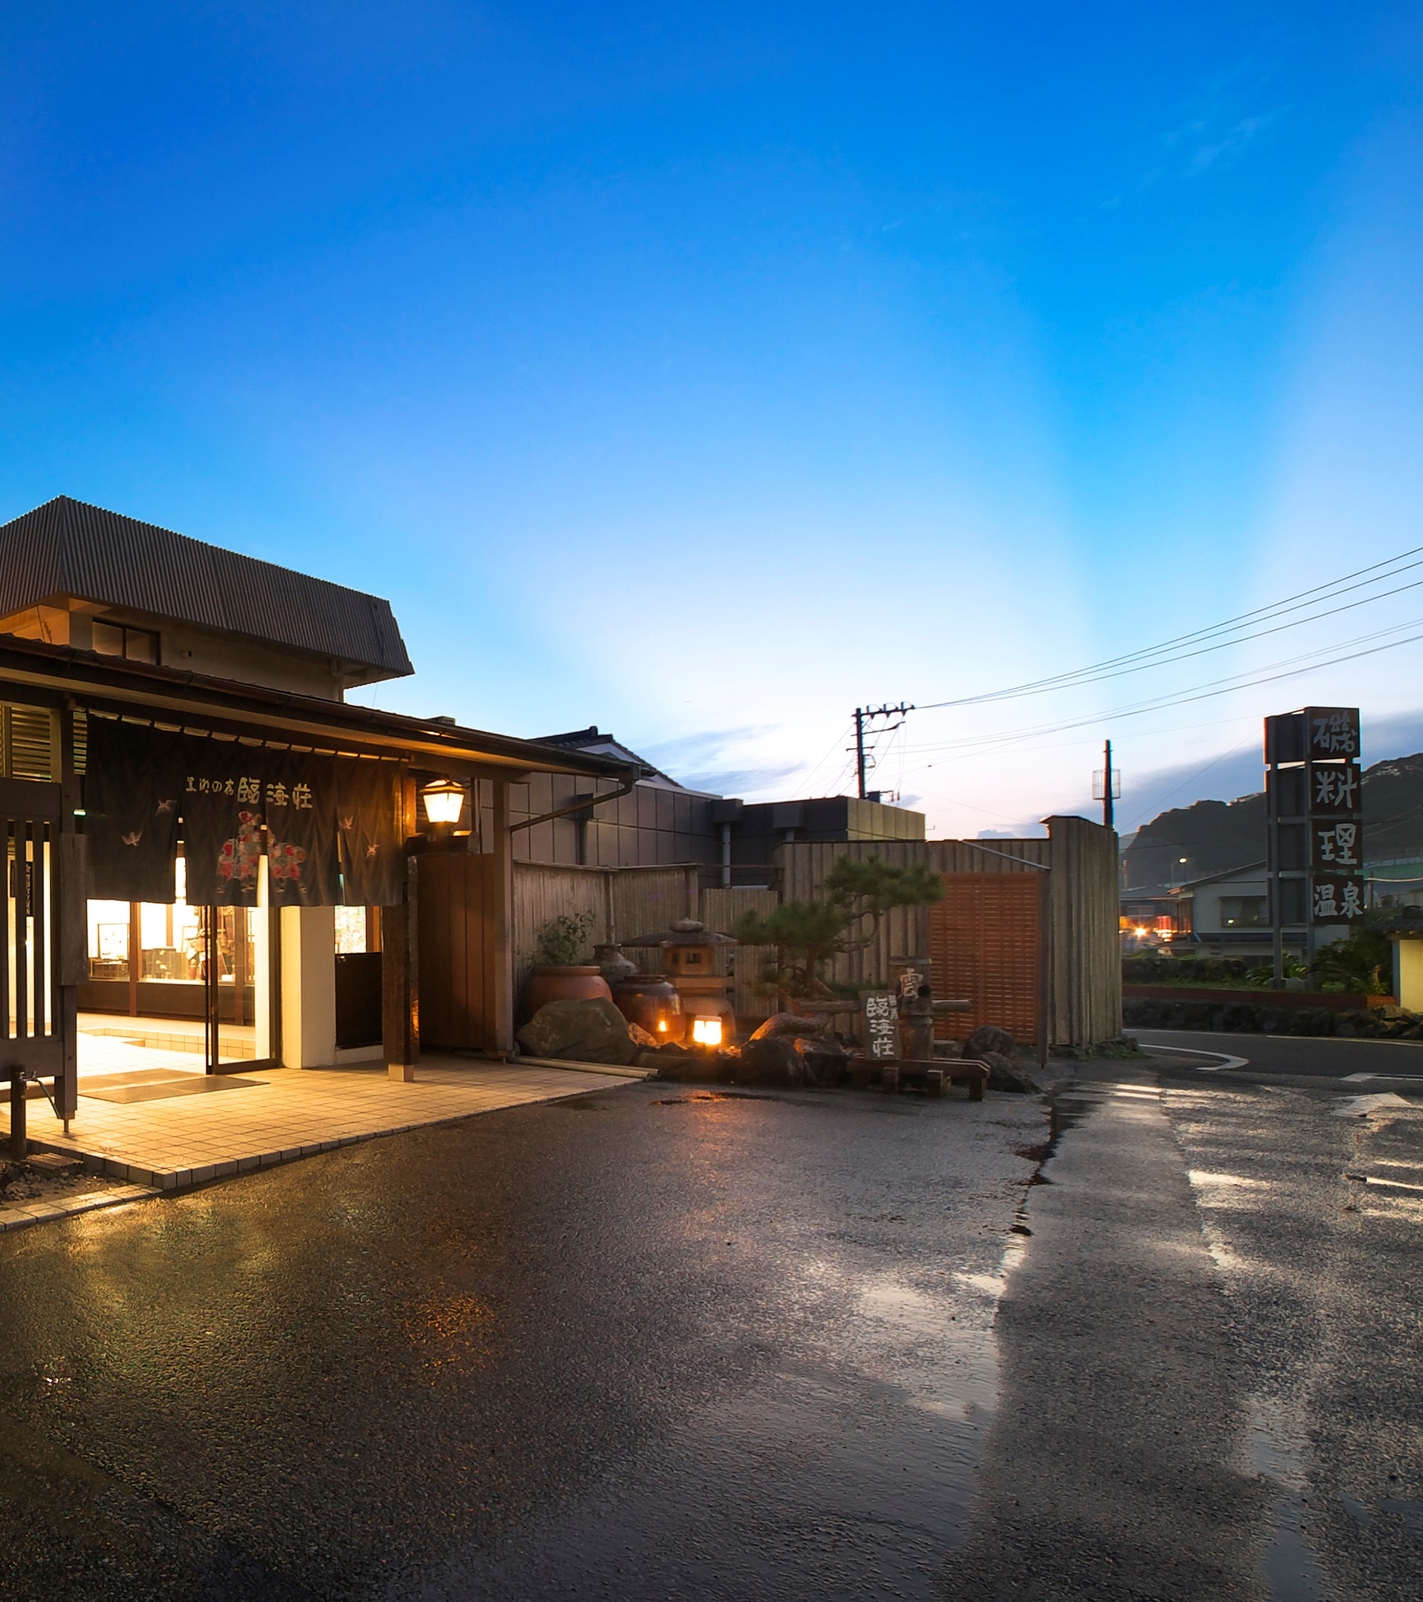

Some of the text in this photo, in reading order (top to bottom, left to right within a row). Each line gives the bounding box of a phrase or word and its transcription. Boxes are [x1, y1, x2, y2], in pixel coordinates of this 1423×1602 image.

[237, 776, 313, 810] 臨海荘
[1313, 881, 1364, 919] 温泉
[866, 996, 895, 1057] 臨海荘
